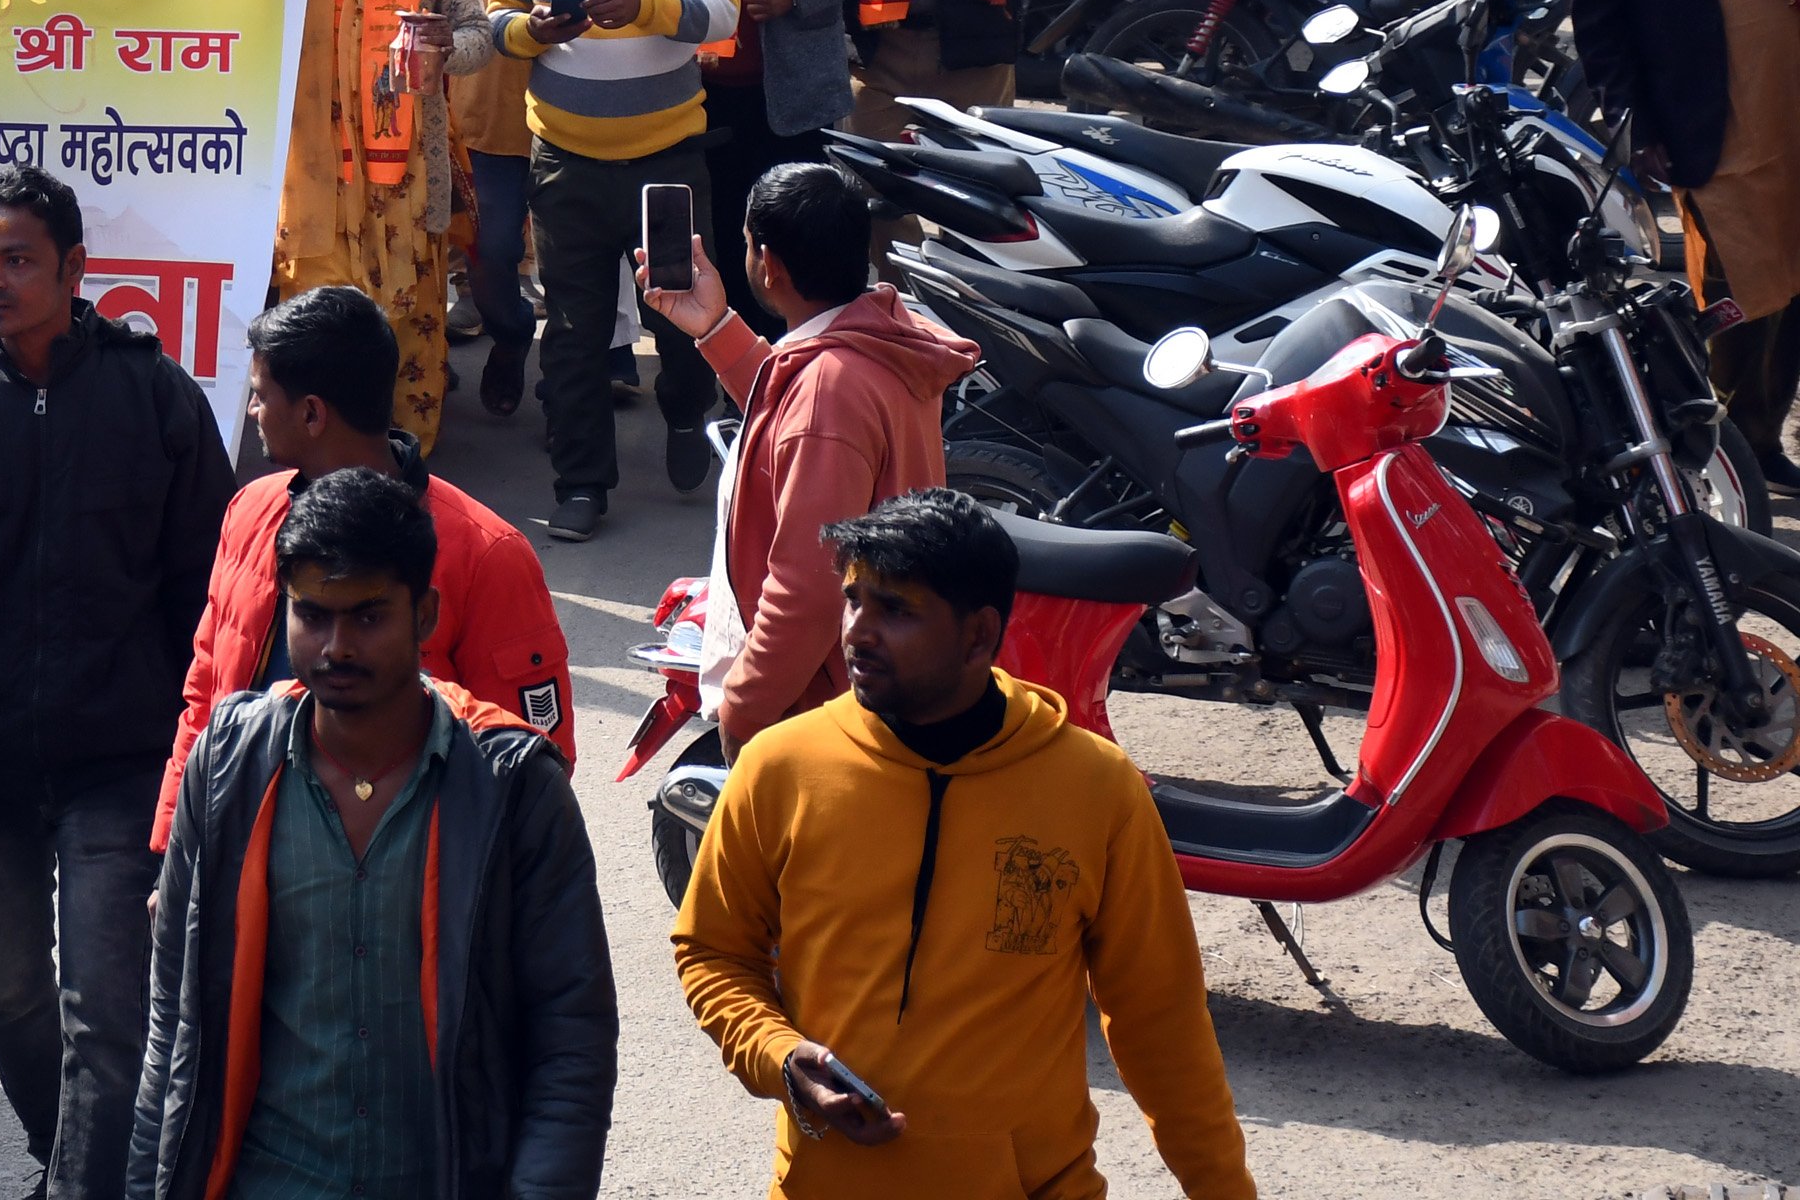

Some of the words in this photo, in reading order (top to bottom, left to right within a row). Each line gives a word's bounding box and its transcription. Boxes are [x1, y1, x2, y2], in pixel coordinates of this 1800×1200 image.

[13, 13, 93, 73] श्री
[114, 30, 240, 73] राम
[60, 106, 248, 186] महोत्सवको
[1695, 555, 1733, 626] YAMAHA
[532, 712, 556, 727] CLASSIC
